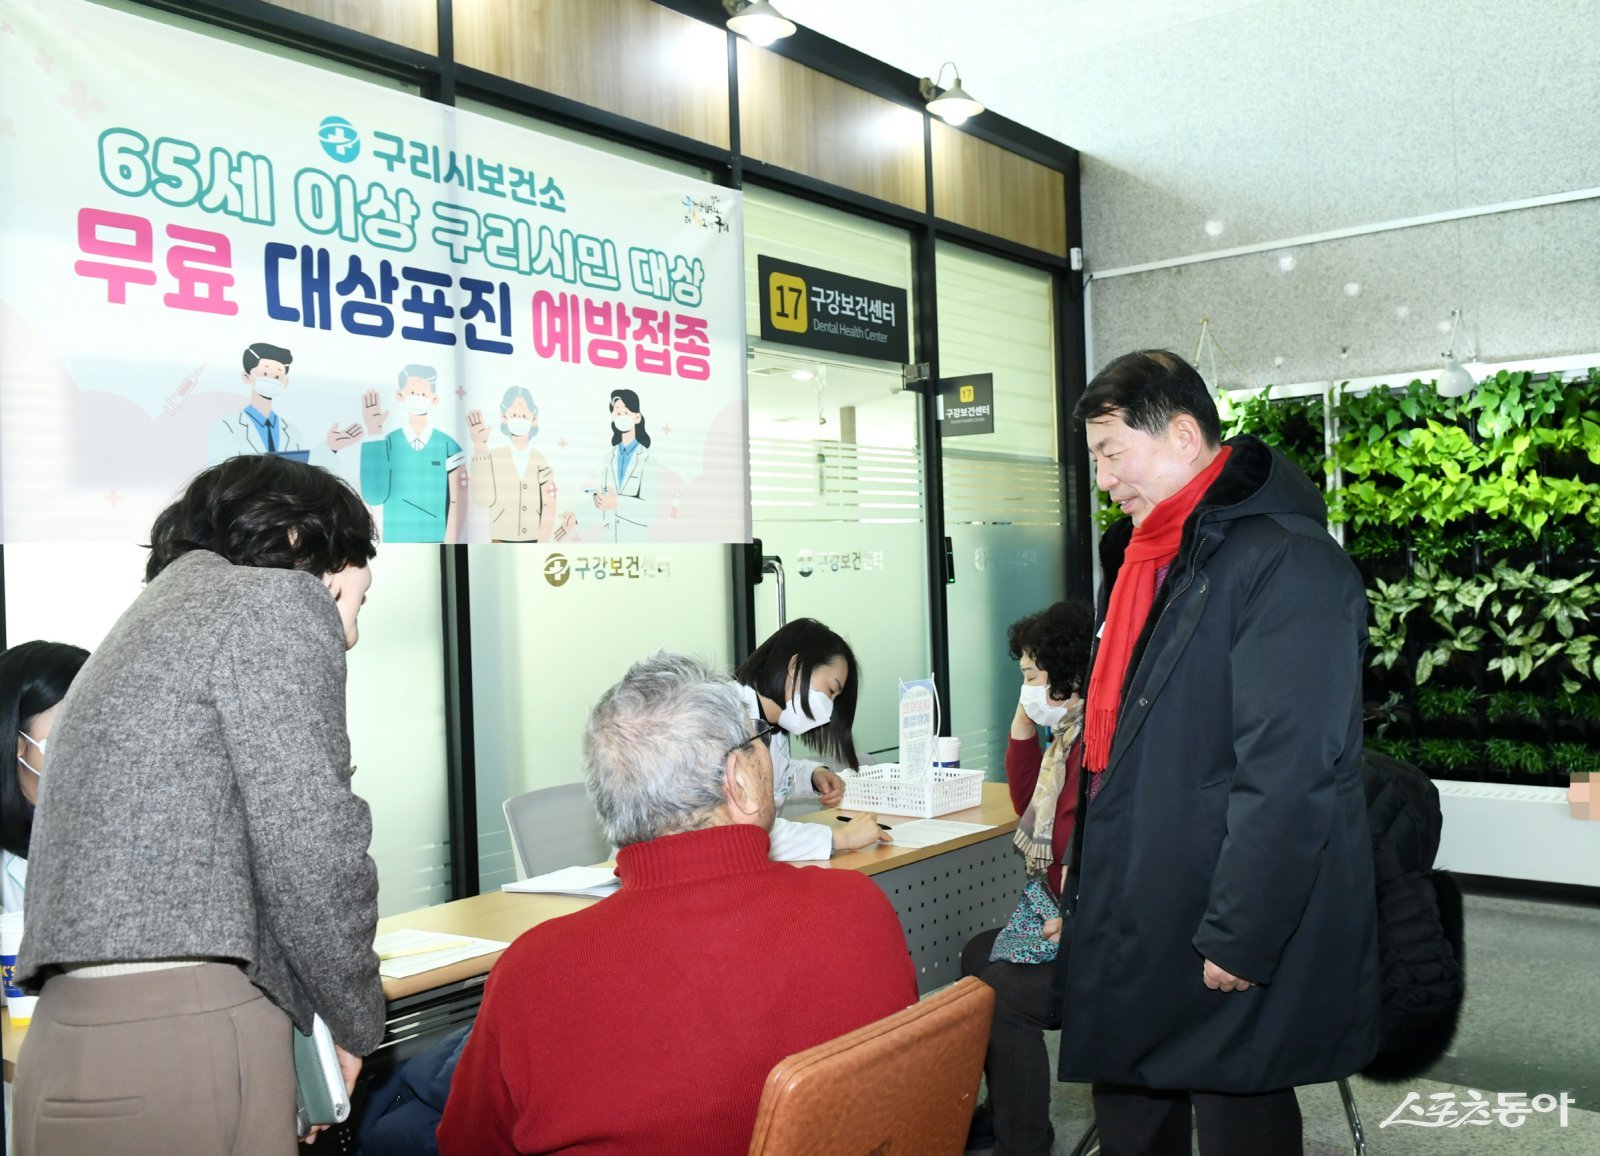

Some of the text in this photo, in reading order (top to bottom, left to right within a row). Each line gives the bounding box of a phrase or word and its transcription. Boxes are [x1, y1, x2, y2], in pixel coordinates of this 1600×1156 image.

[373, 131, 566, 213] 구리시보건소
[98, 127, 704, 308] 65세 이상 구리시민 대상
[74, 208, 710, 381] 무료 대상포진 예방접종
[775, 285, 803, 320] 17
[811, 286, 896, 327] 구강보건센터
[813, 318, 888, 343] Dental Health Center
[945, 404, 990, 419] 구강보건센터
[962, 389, 973, 399] 17
